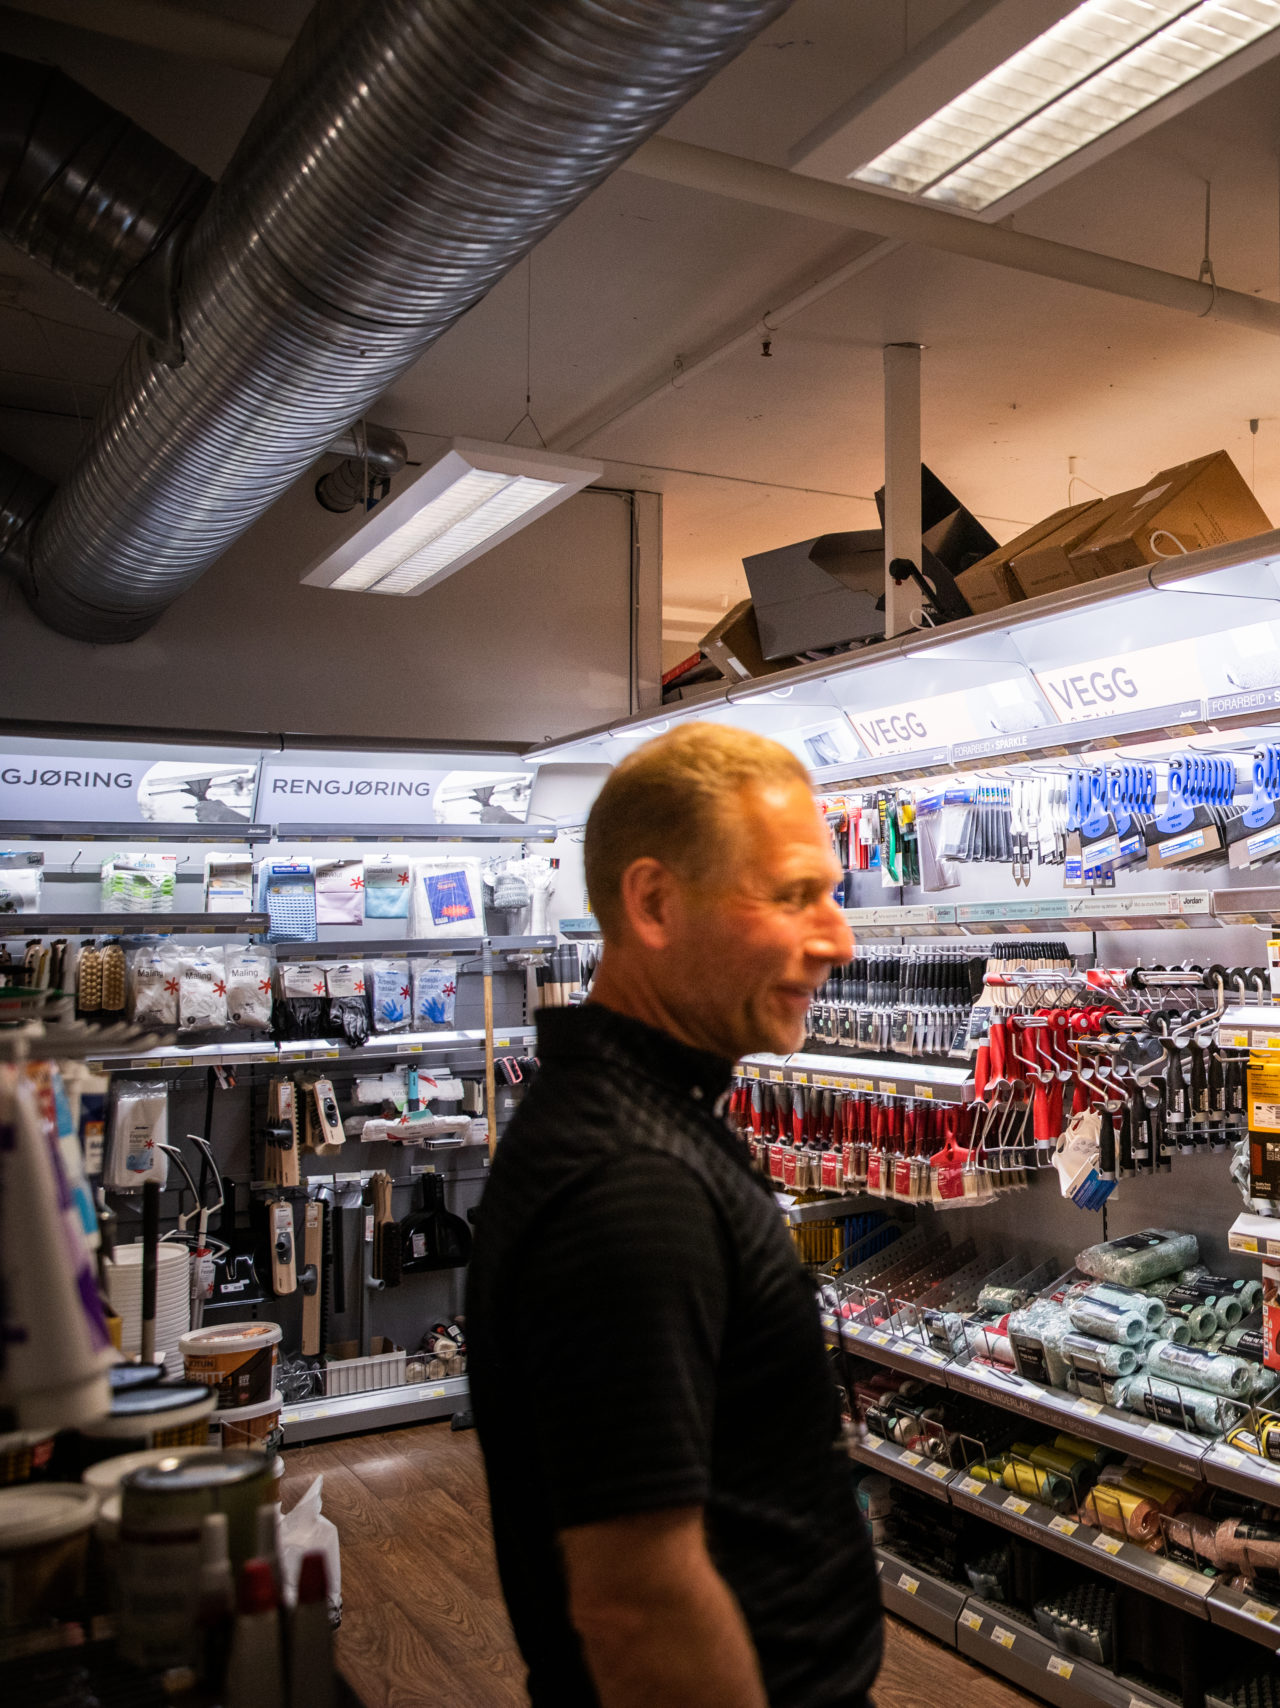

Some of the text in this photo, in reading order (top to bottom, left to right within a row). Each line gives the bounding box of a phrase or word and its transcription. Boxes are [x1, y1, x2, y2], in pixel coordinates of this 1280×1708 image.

[1048, 667, 1139, 710] VEGG
[1212, 695, 1266, 713] FORARBEID
[859, 712, 928, 747] VEGG
[954, 735, 1028, 758] FORARBEID SPARKLE
[272, 778, 431, 798] RENGJØRING
[138, 968, 164, 979] Maling
[185, 971, 212, 981] Maling
[232, 968, 259, 979] Maling
